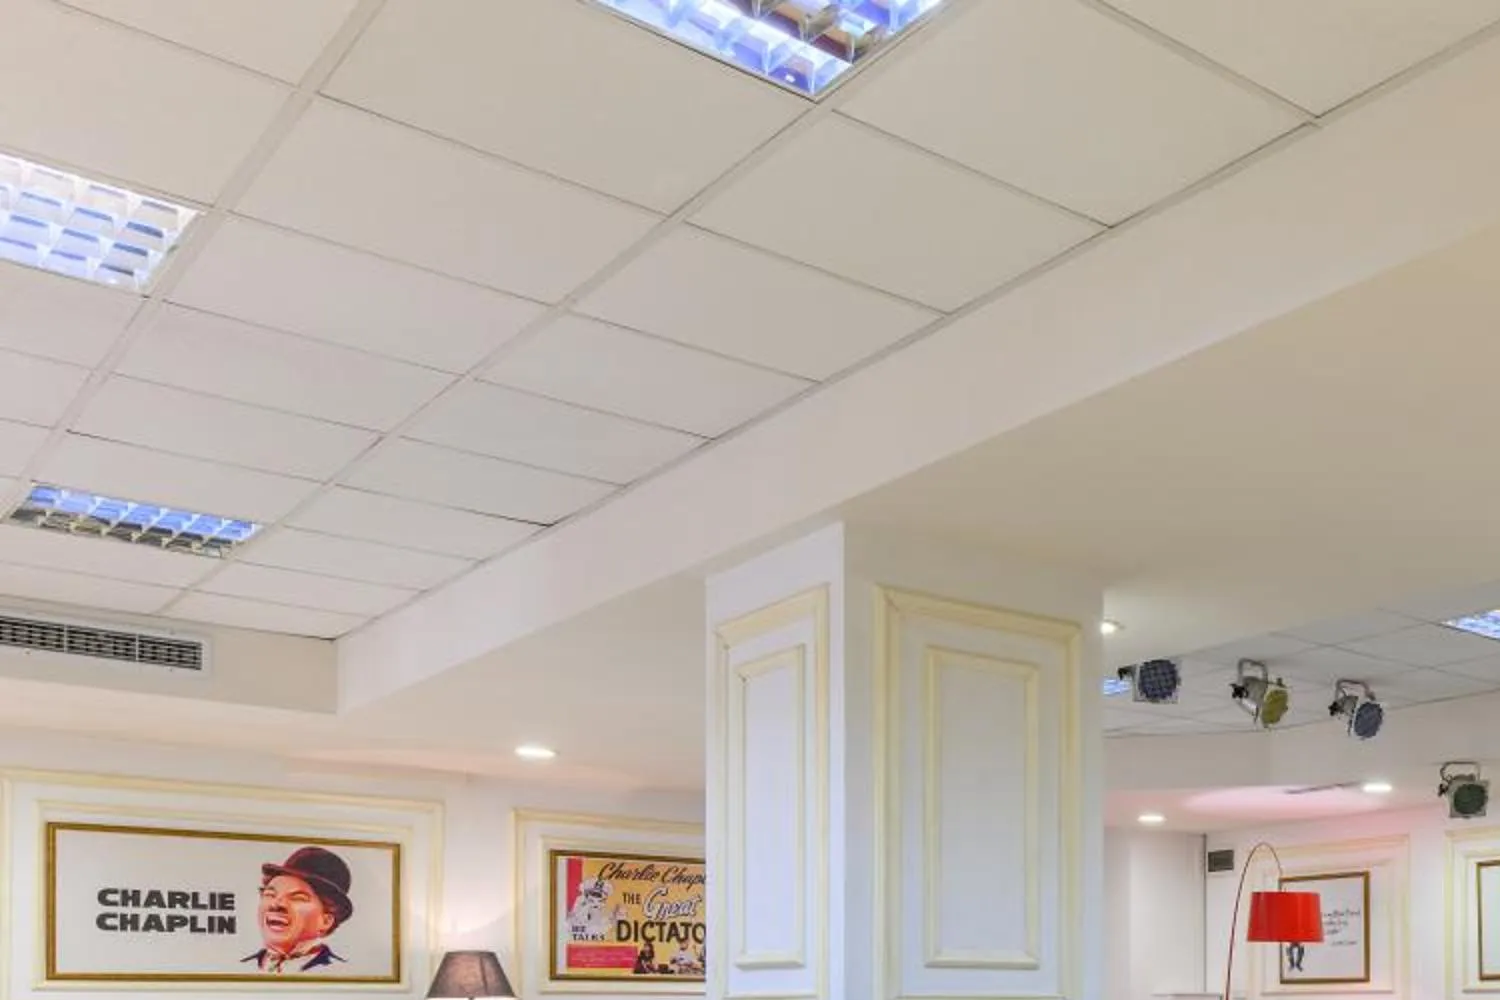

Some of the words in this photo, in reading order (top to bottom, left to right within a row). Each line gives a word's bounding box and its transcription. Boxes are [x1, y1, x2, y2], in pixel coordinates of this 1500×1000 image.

[599, 861, 660, 882] Charlie
[661, 865, 706, 890] Chap
[97, 888, 235, 910] CHARLIE
[622, 892, 641, 905] THE
[643, 887, 703, 921] Great
[96, 912, 237, 934] CHAPLIN
[616, 920, 706, 943] DICTATO
